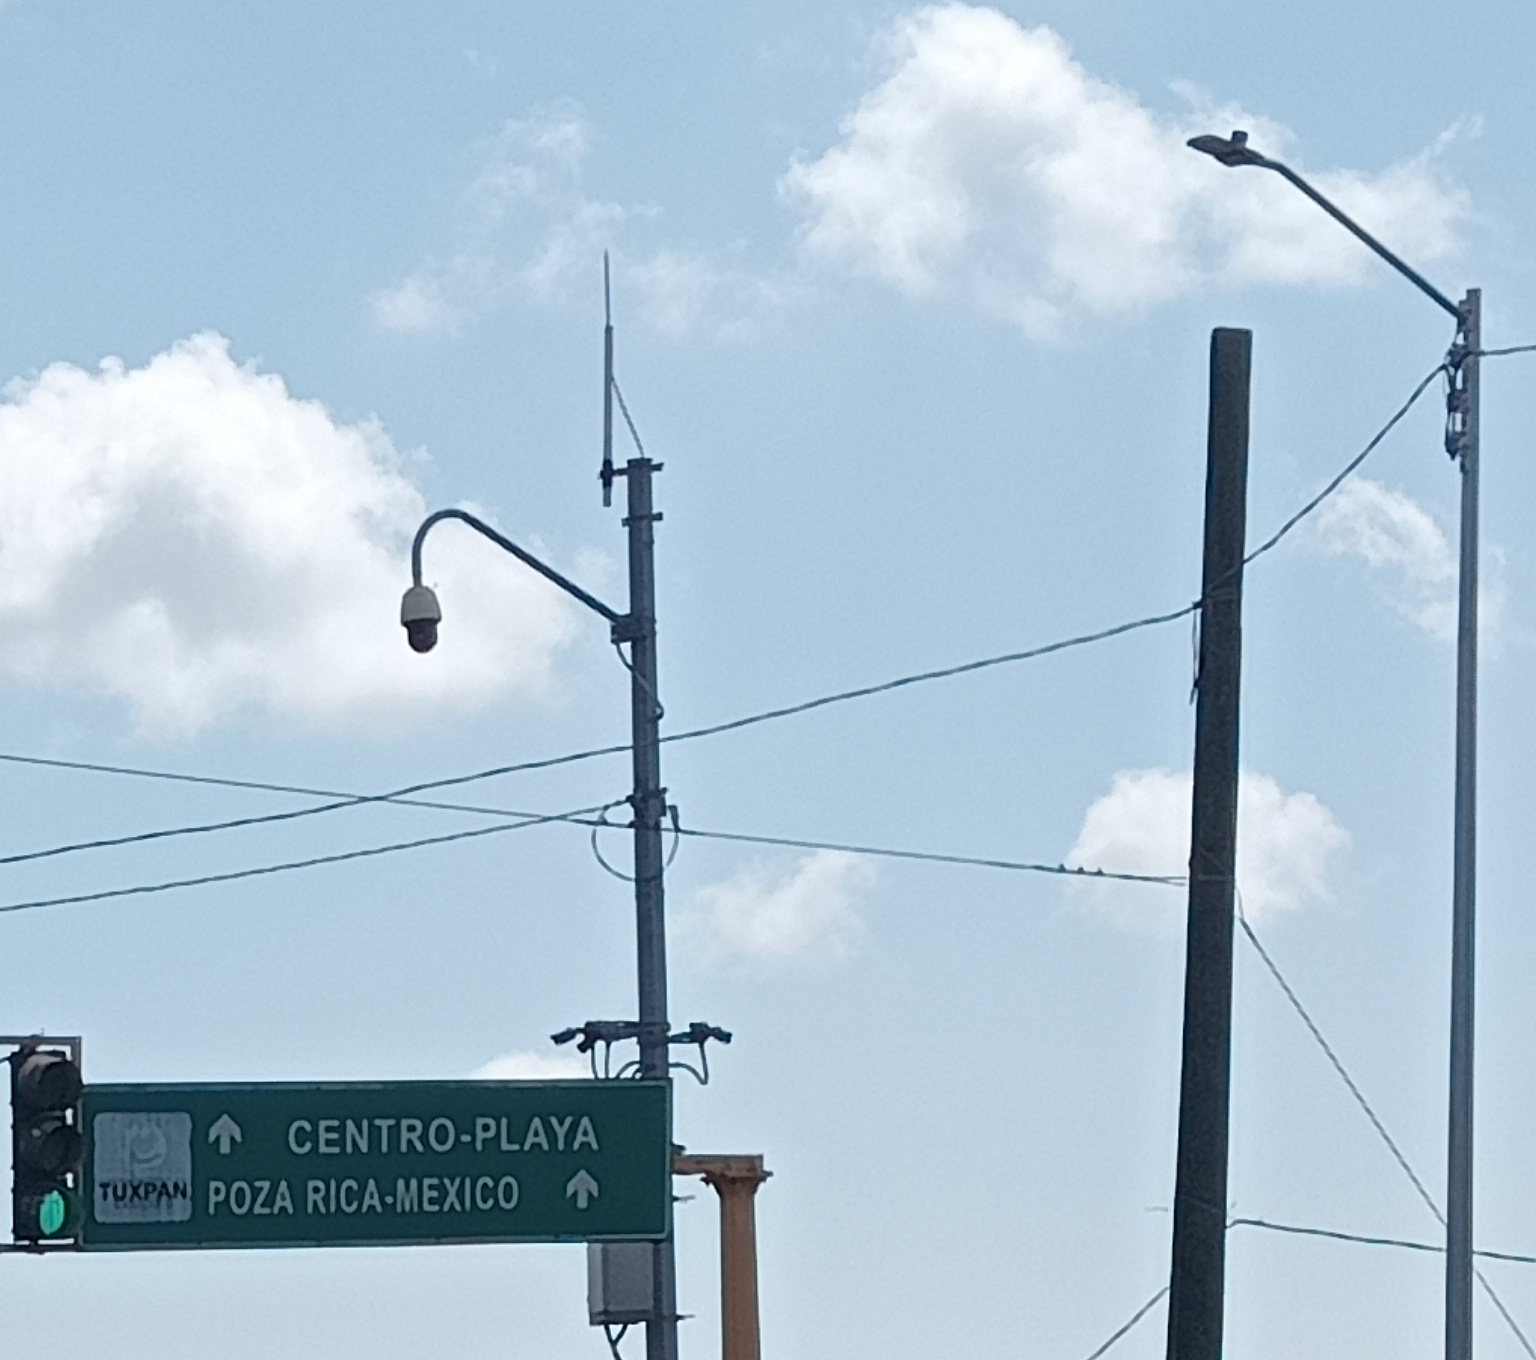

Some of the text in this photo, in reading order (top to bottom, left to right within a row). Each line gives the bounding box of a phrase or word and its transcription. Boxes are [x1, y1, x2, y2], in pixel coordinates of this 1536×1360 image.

[288, 1115, 600, 1155] CENTRO-PLAYA
[98, 1180, 188, 1203] TUXPAN
[208, 1175, 520, 1216] POZA RICA-MEXICO
